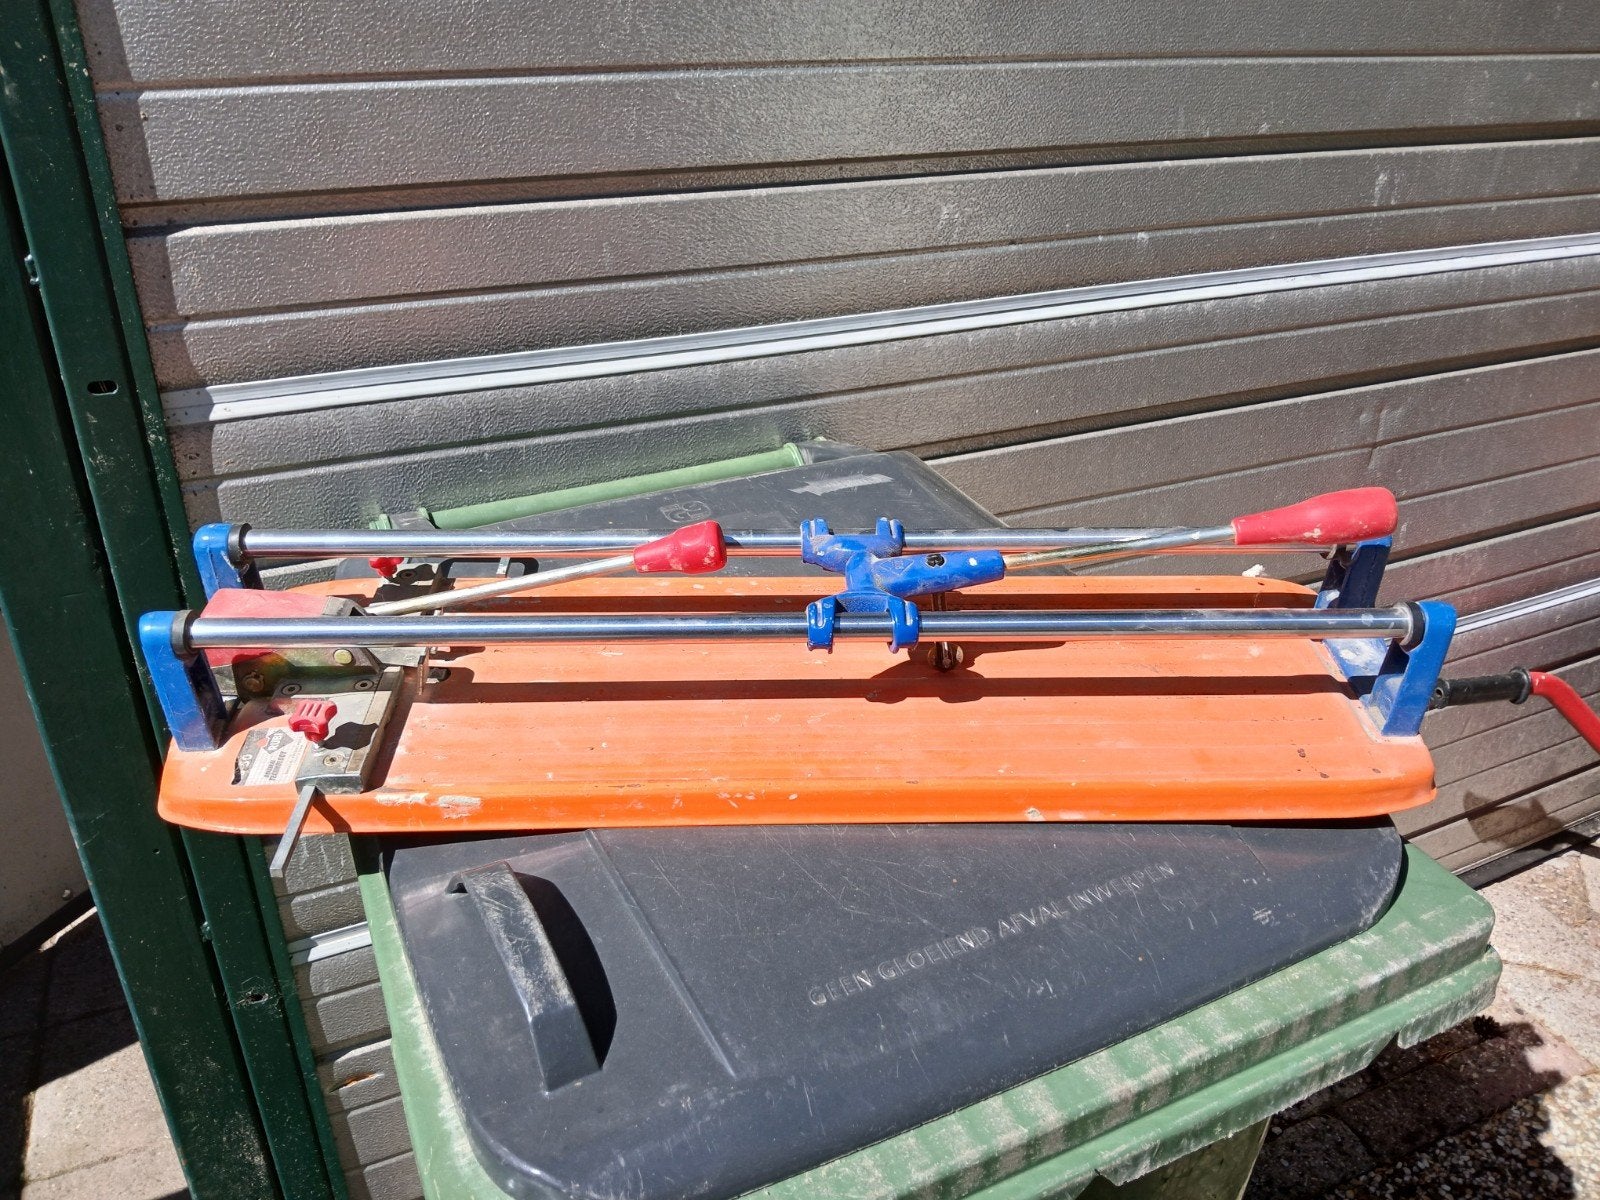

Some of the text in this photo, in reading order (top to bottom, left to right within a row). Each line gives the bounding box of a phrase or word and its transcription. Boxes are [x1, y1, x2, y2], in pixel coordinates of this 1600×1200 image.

[267, 733, 283, 751] RUBI
[809, 860, 1176, 1006] GEEN GLOEIEND AFVAL INWERPEN
